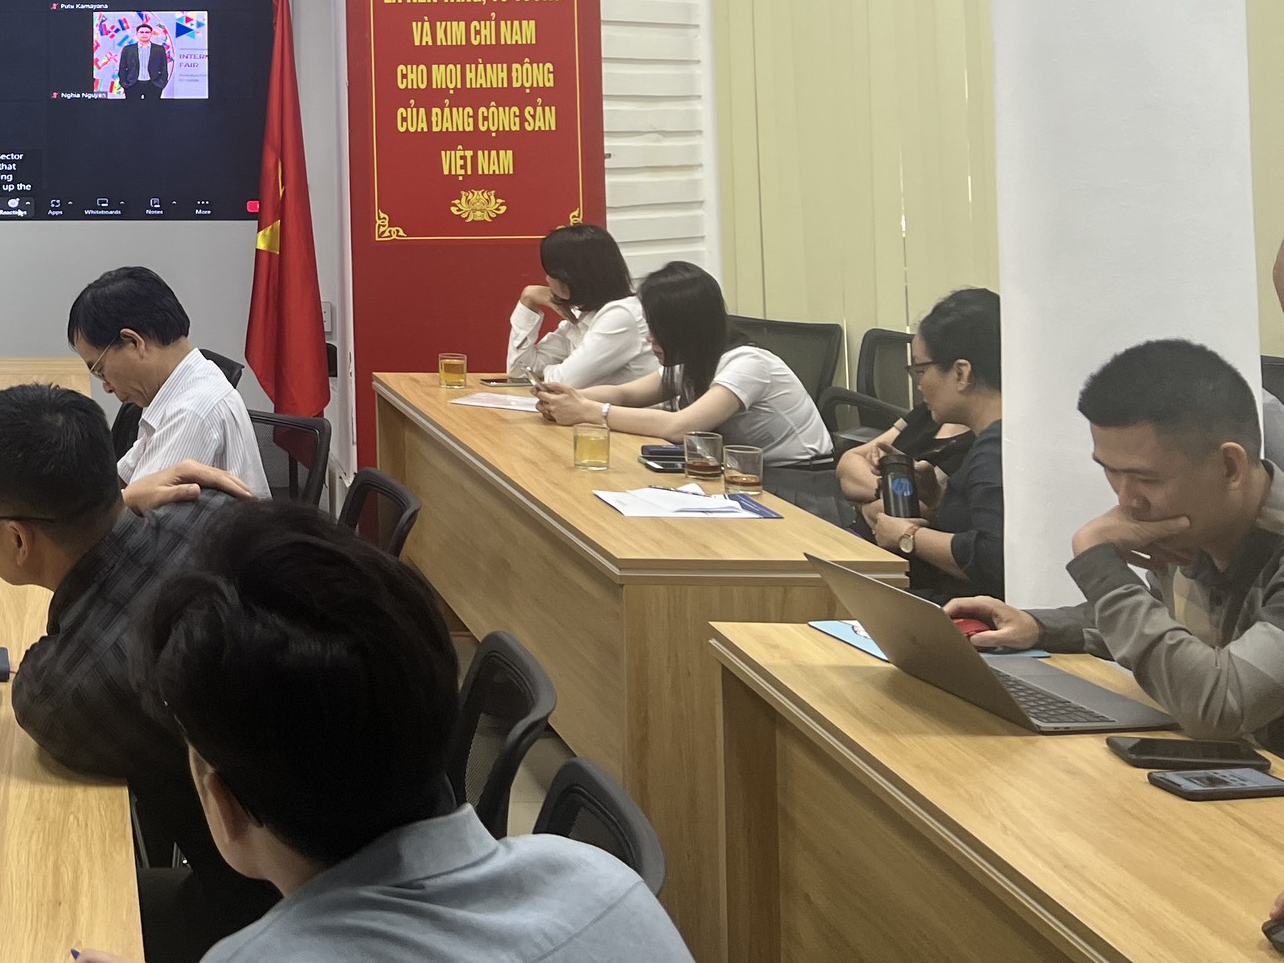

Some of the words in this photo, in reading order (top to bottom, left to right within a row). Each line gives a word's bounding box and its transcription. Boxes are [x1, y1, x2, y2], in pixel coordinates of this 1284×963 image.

[412, 17, 433, 46] VÀ
[436, 21, 466, 46] KIM
[470, 13, 496, 46] CHỈ
[500, 20, 536, 45] NAM
[396, 65, 428, 90] CHO
[431, 64, 462, 95] MỌI
[465, 59, 508, 89] HÀNH
[511, 58, 555, 94] ĐỘNG
[396, 100, 428, 133] CỦA
[431, 99, 474, 132] ĐẢNG
[478, 102, 520, 137] CỘNG
[524, 99, 556, 131] SẢN
[440, 145, 474, 181] VIỆT
[477, 150, 514, 175] NAM
[2, 184, 15, 192] up
[16, 182, 32, 191] the
